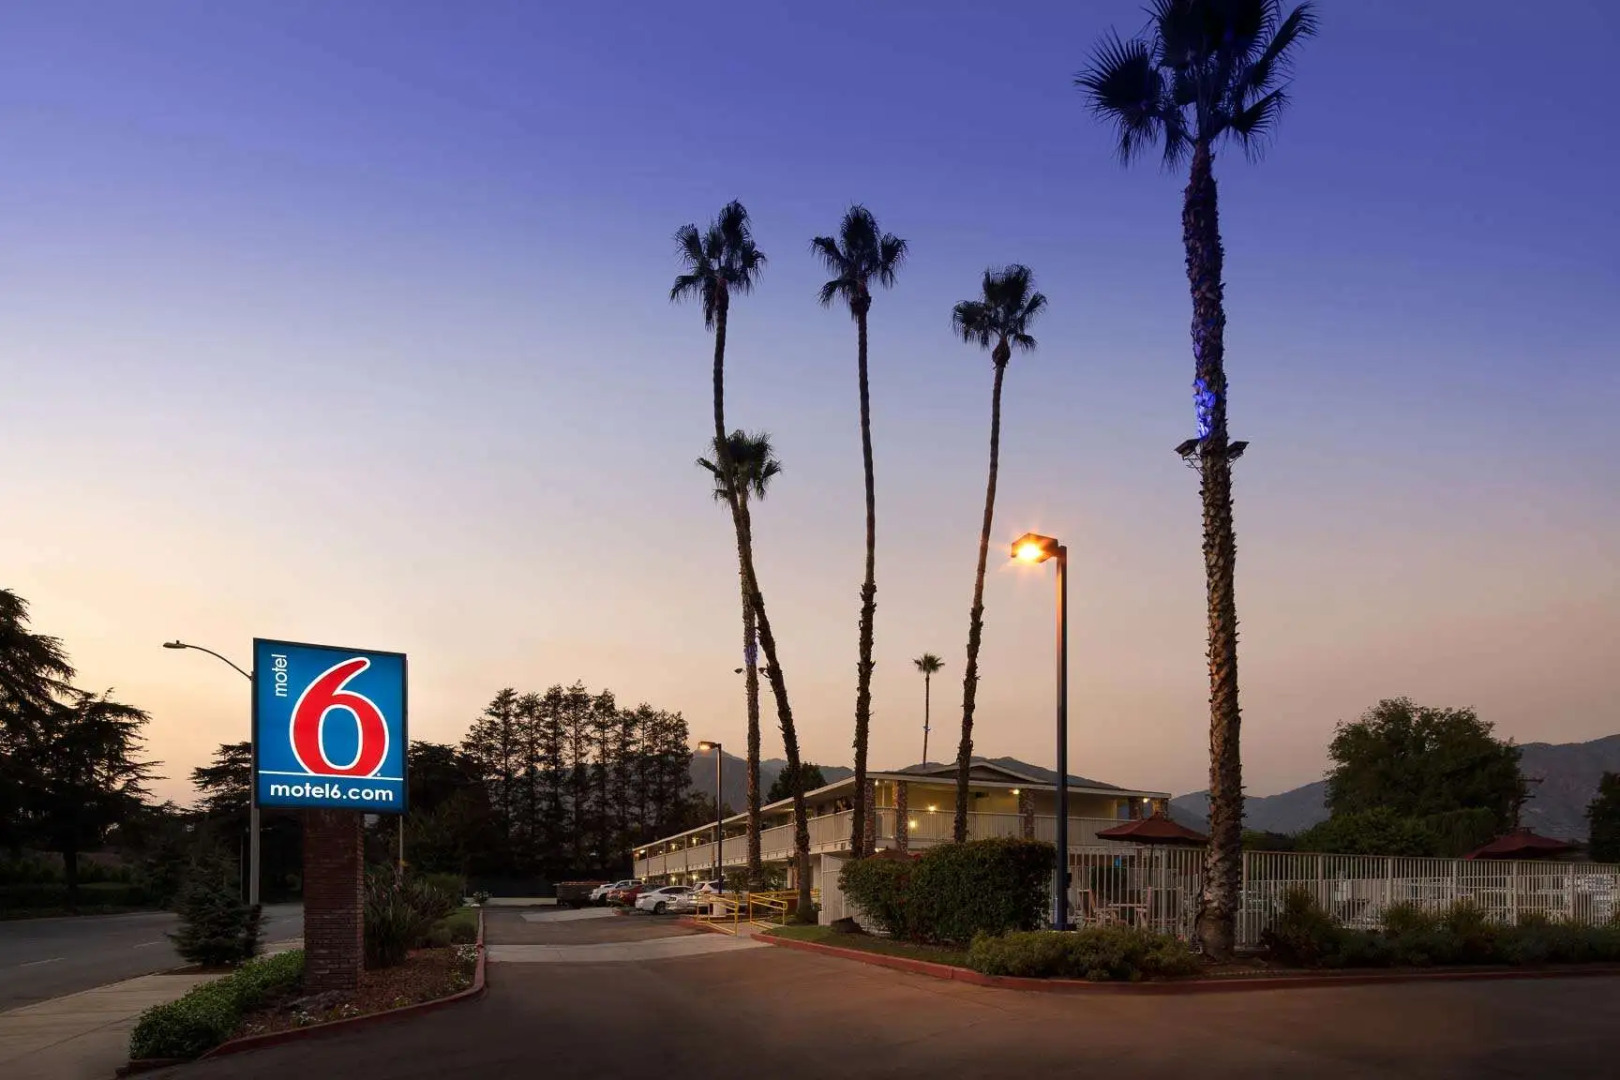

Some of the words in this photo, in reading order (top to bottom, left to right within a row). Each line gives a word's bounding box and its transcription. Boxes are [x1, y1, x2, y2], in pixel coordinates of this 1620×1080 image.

[271, 654, 287, 697] motel
[289, 657, 389, 777] 6
[270, 782, 393, 802] motel6.com
